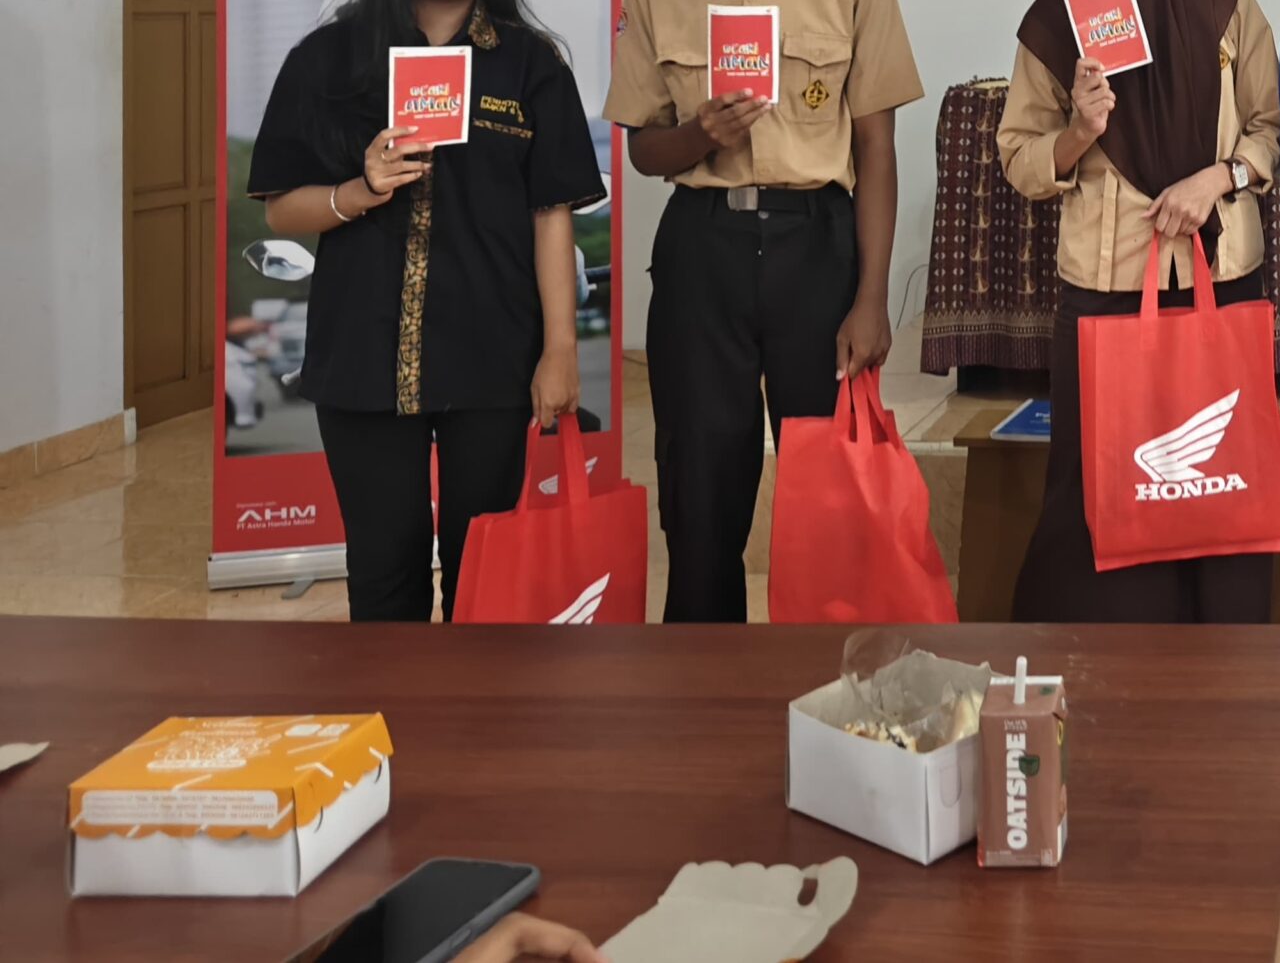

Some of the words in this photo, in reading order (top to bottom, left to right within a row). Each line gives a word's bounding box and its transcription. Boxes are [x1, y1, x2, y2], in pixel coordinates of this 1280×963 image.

[1135, 473, 1248, 502] HONDA
[237, 504, 317, 523] AHM
[1005, 732, 1028, 850] OATSIDE
